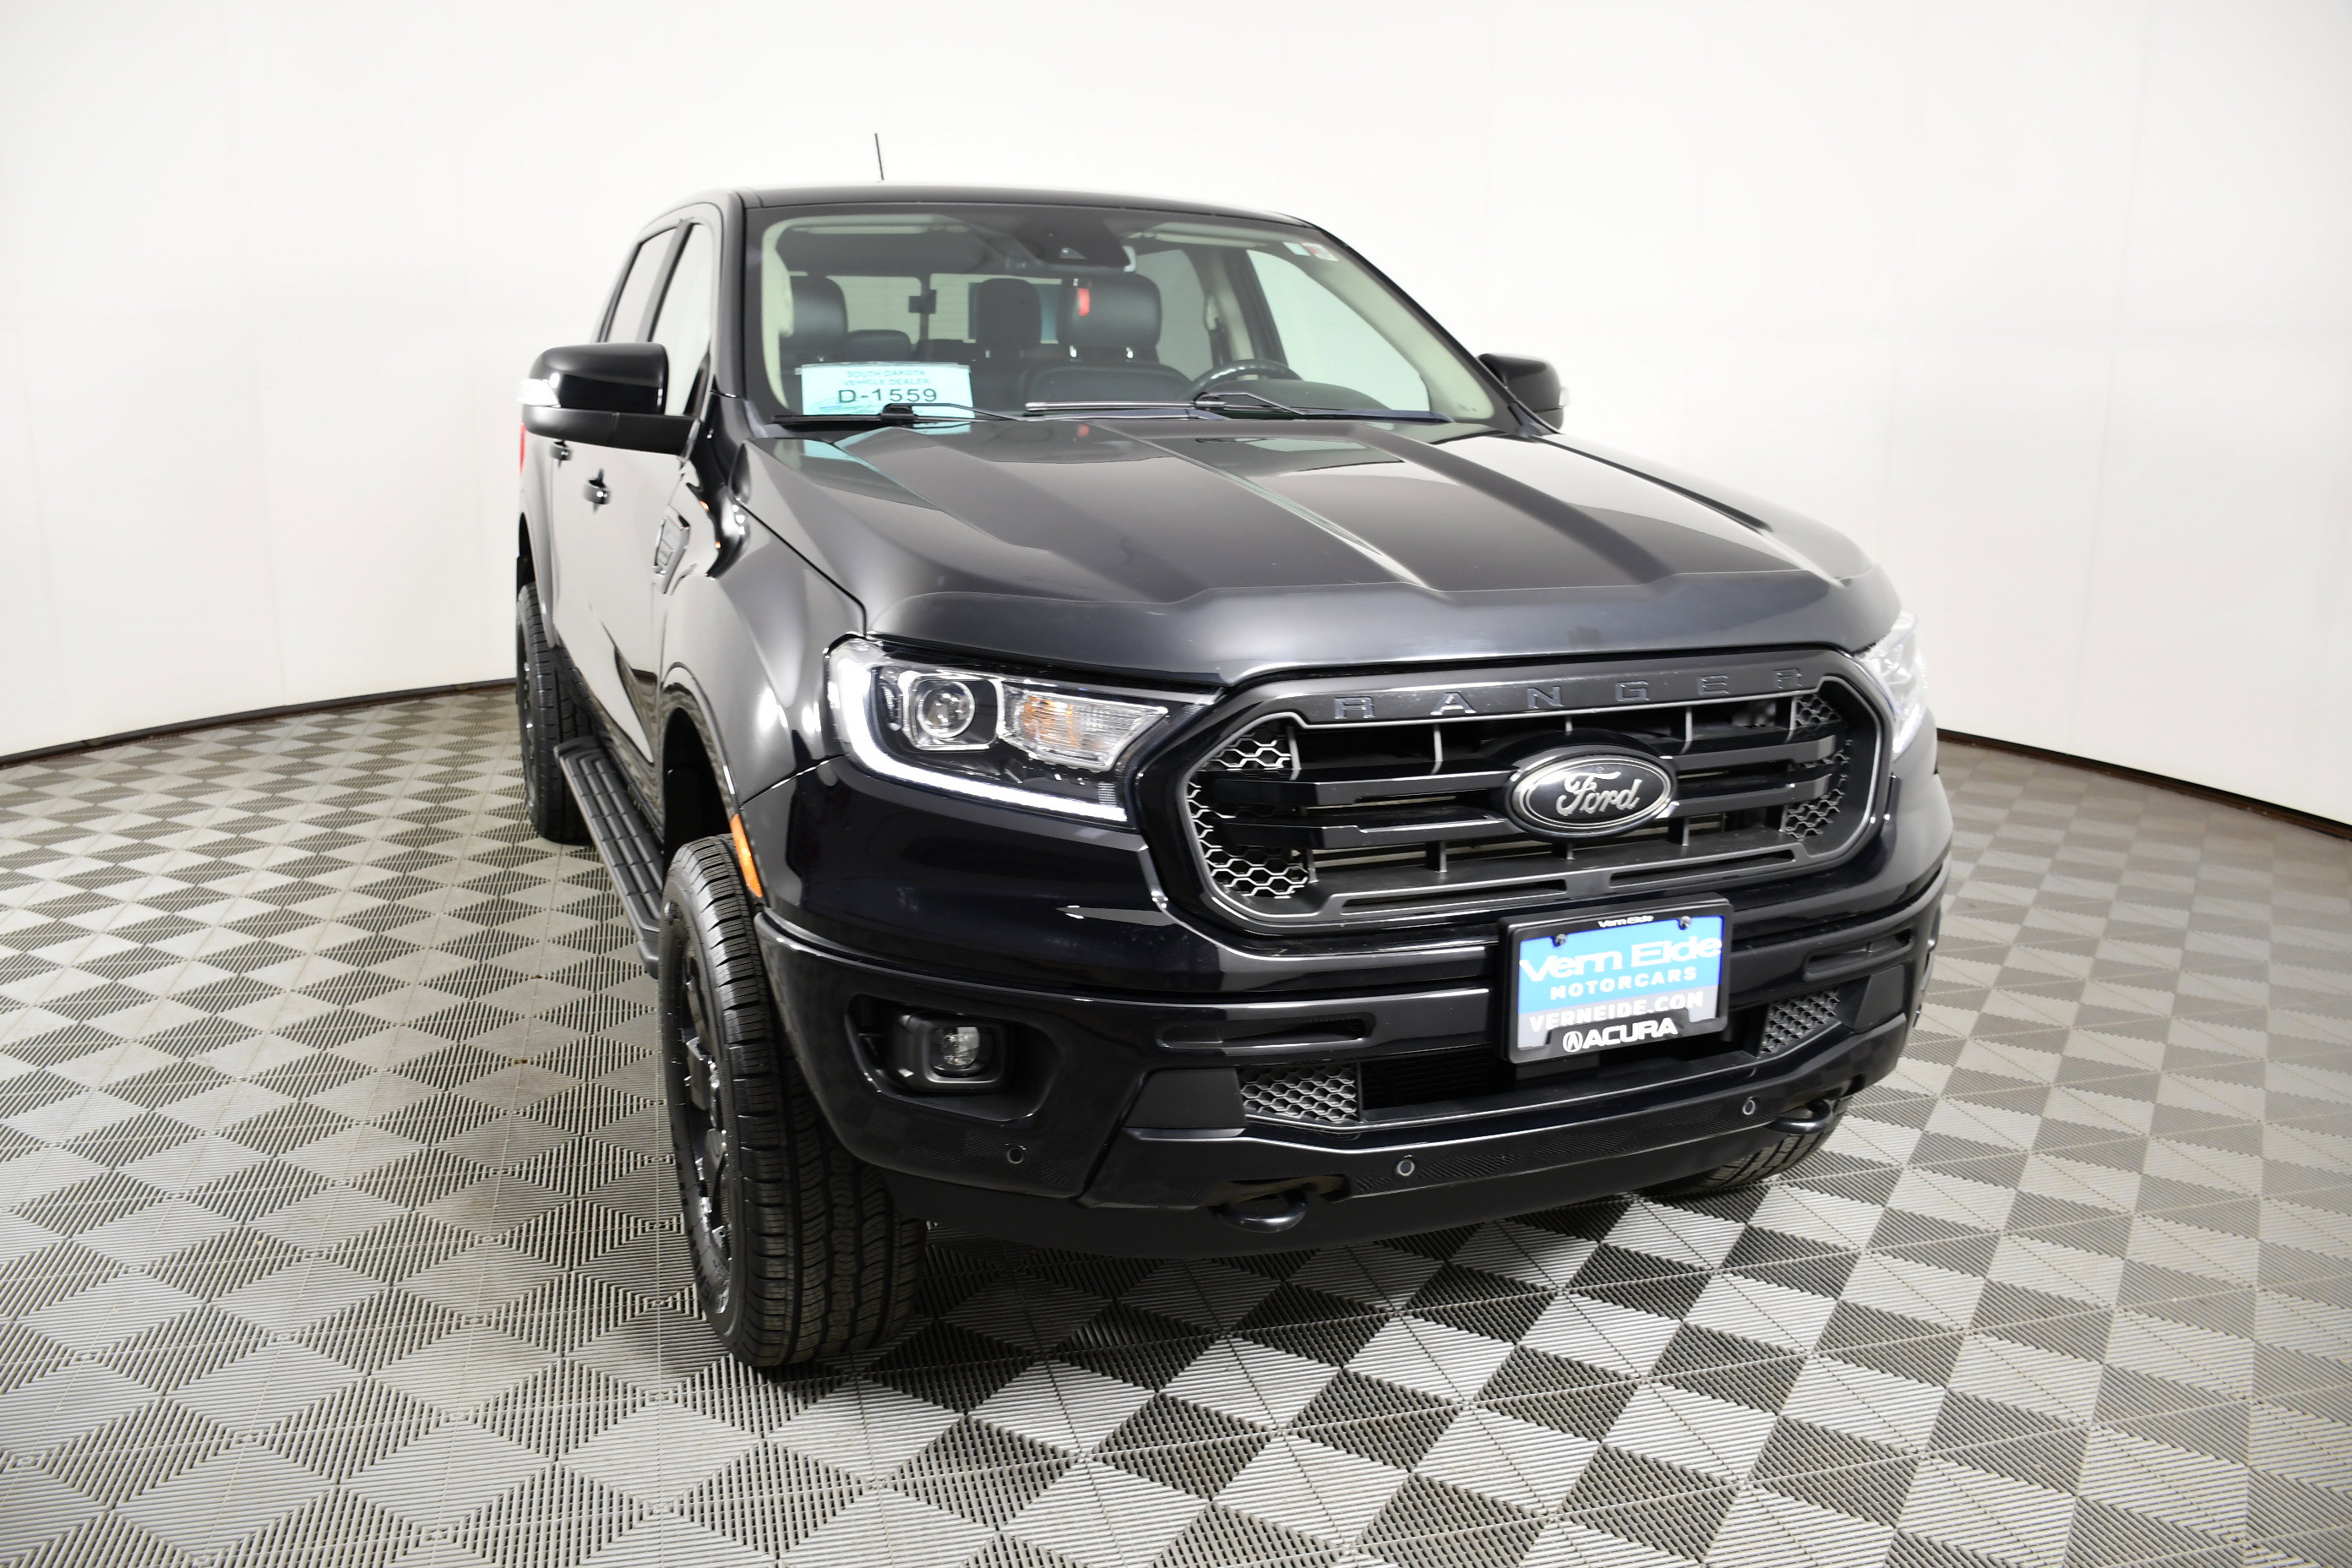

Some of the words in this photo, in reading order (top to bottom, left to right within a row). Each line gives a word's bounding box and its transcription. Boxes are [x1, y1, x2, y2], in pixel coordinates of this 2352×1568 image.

[838, 388, 937, 403] D-1559
[1333, 667, 1803, 720] RANGER
[1555, 770, 1643, 817] Ford
[1519, 950, 1623, 983] Vern
[1630, 936, 1723, 968] Eide
[1549, 966, 1697, 1000] MOTORCARS
[1529, 991, 1704, 1032] VERNEIDE.COM
[1582, 1017, 1679, 1049] ACURA
